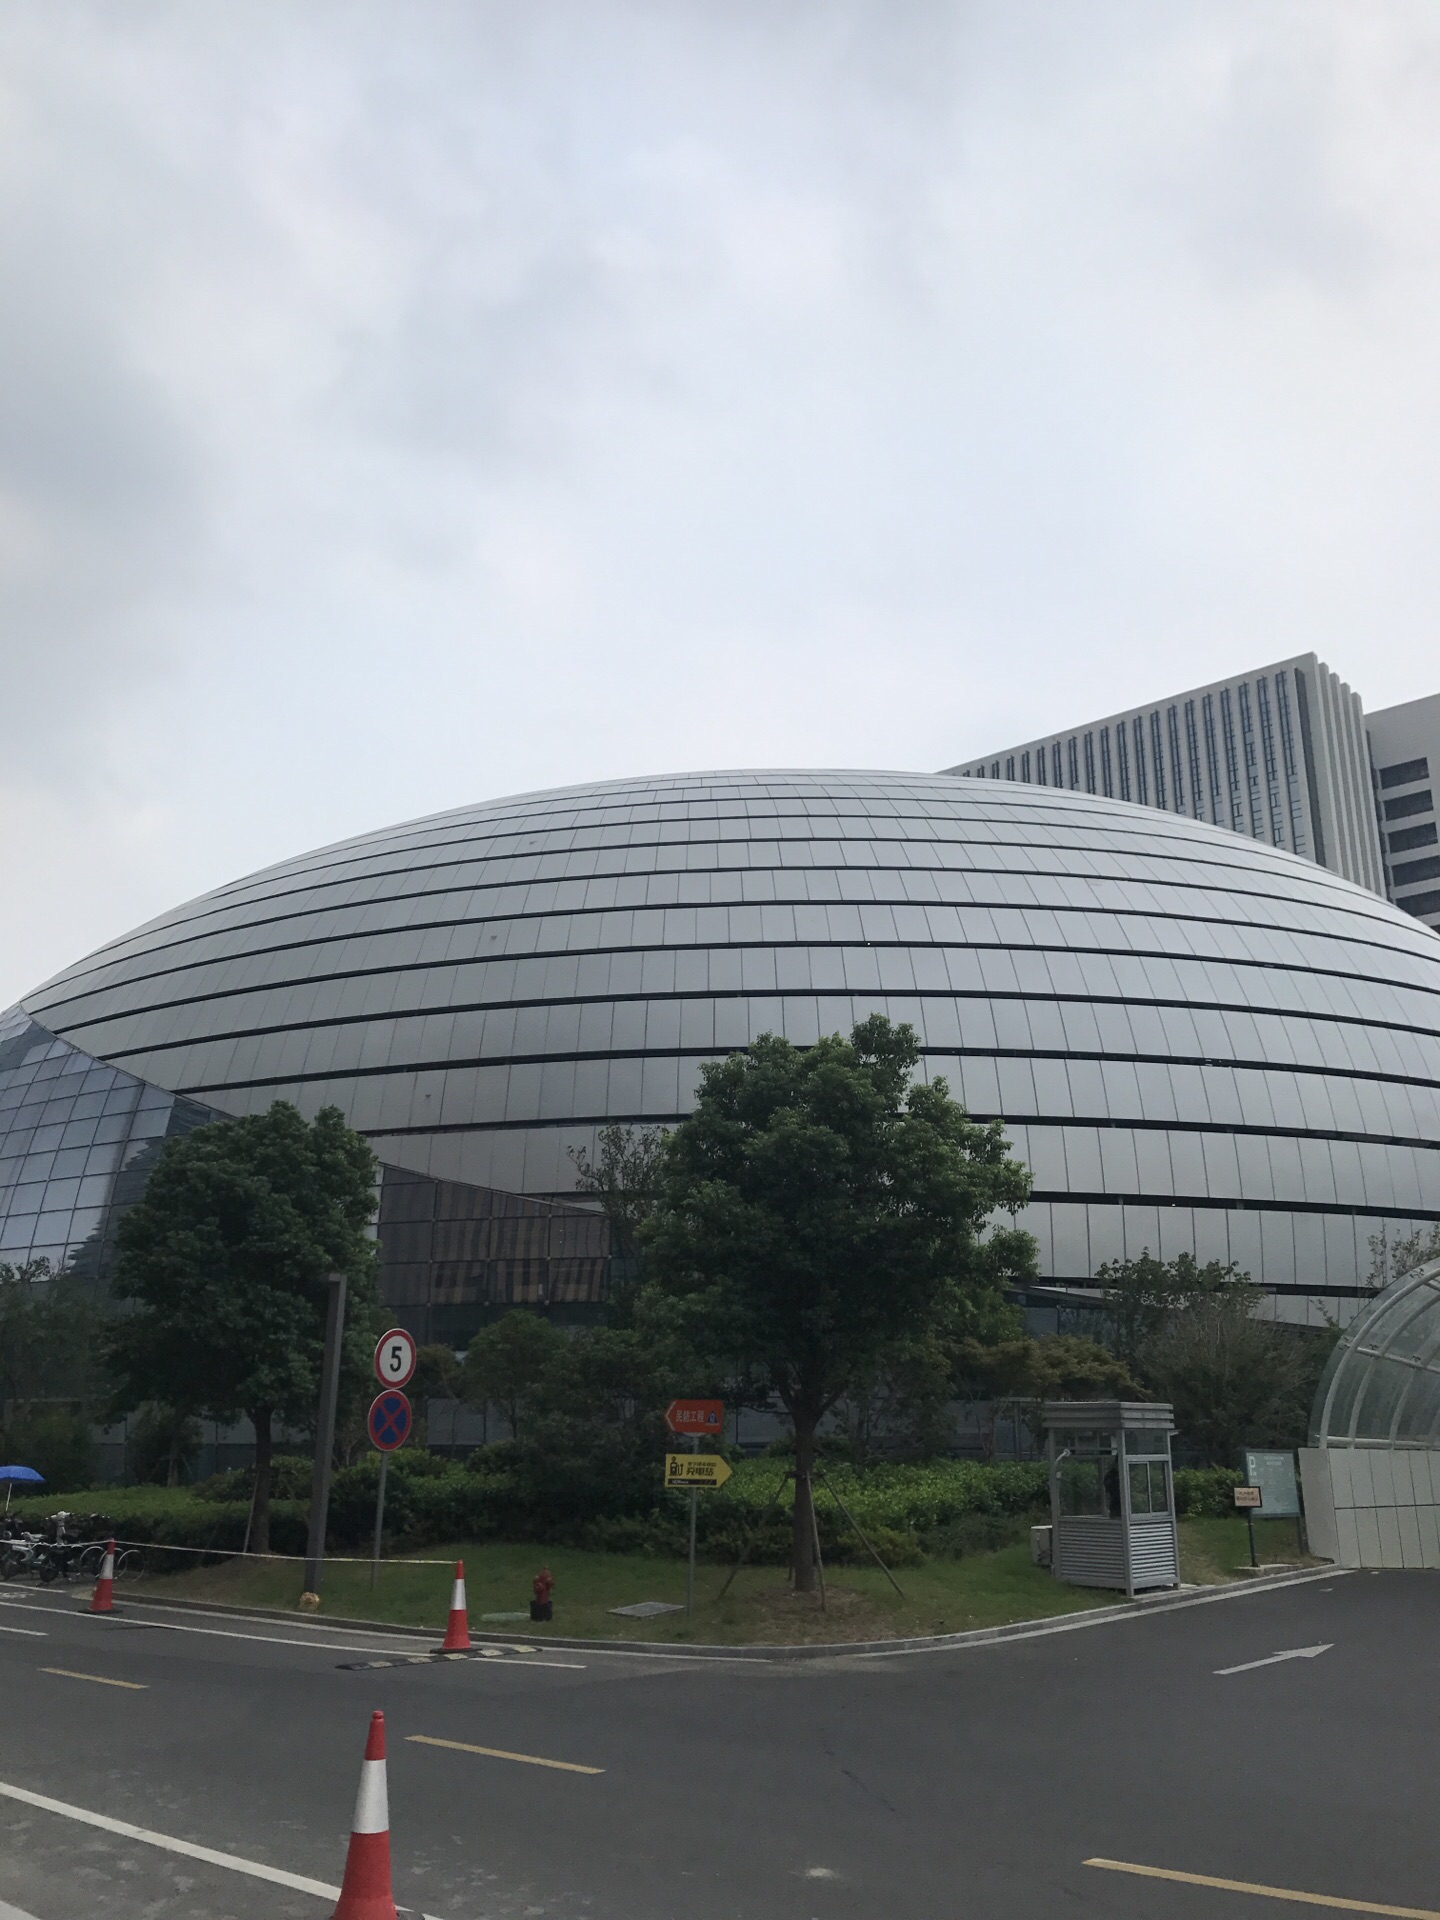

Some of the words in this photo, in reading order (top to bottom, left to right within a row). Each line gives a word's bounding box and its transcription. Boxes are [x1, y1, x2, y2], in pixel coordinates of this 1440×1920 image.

[390, 1346, 402, 1372] 5
[687, 1467, 714, 1476] 充电站
[1248, 1456, 1256, 1476] P
